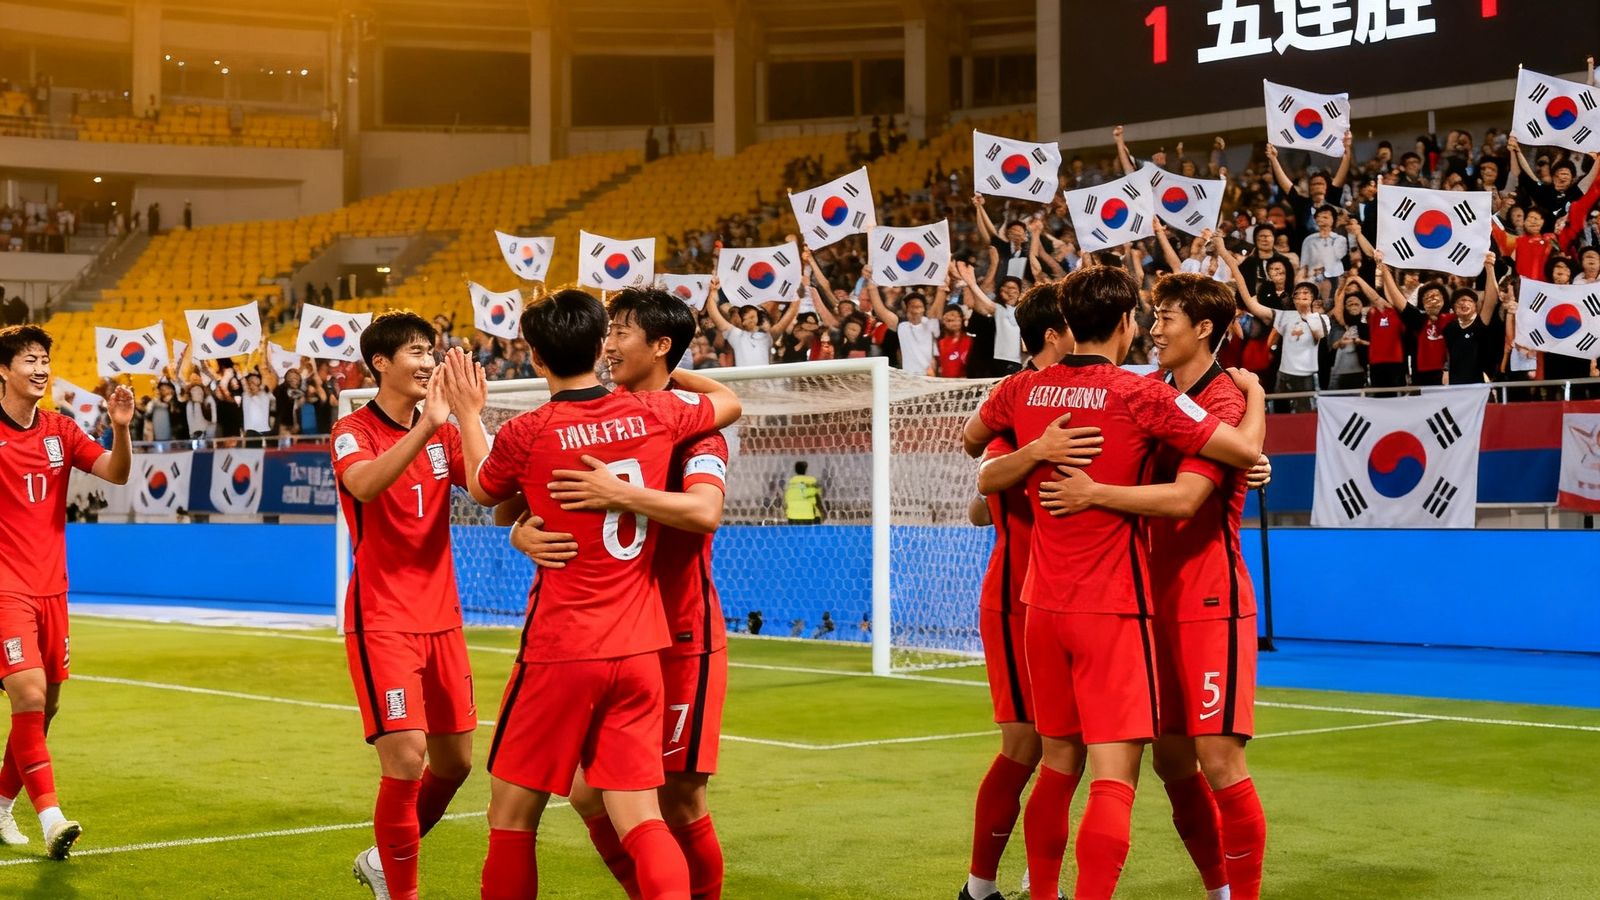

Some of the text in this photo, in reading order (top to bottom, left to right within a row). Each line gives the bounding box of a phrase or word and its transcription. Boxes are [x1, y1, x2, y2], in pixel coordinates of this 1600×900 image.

[1145, 6, 1167, 64] 1
[411, 484, 424, 518] 1
[1202, 671, 1220, 708] 5
[669, 703, 690, 743] 7
